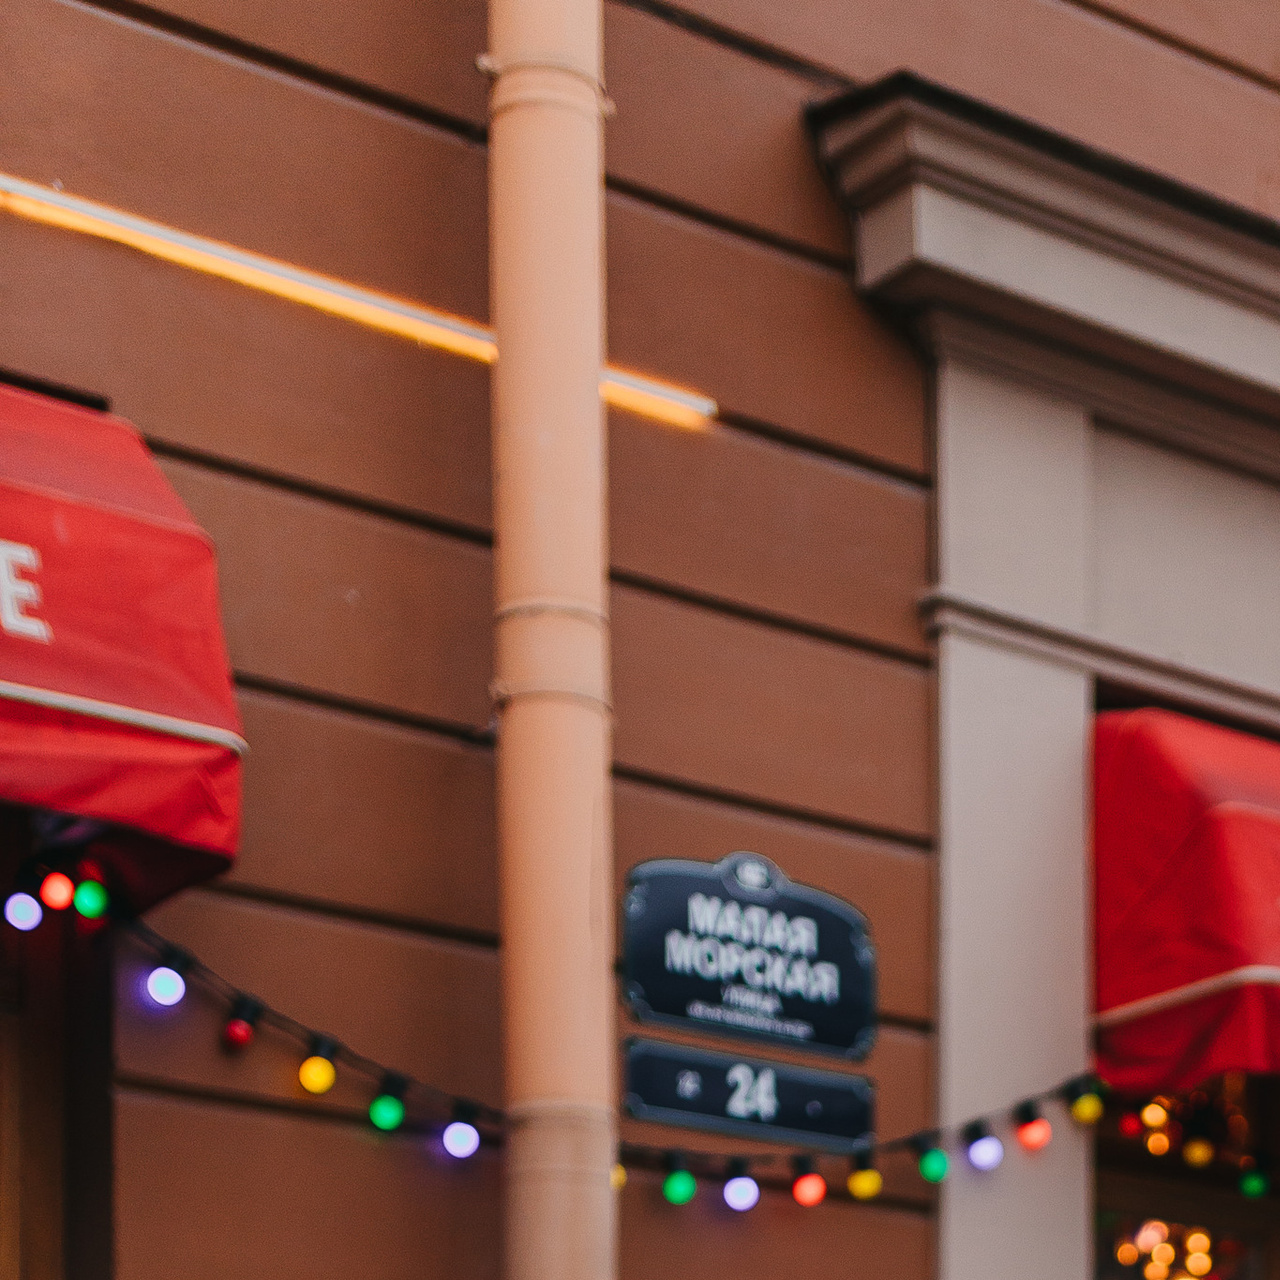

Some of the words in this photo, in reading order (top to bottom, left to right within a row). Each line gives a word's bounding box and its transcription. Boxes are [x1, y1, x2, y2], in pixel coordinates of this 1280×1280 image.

[689, 893, 818, 957] МАЛАЯ
[665, 929, 840, 1004] МОРСКАЯ
[726, 1064, 779, 1121] 24
